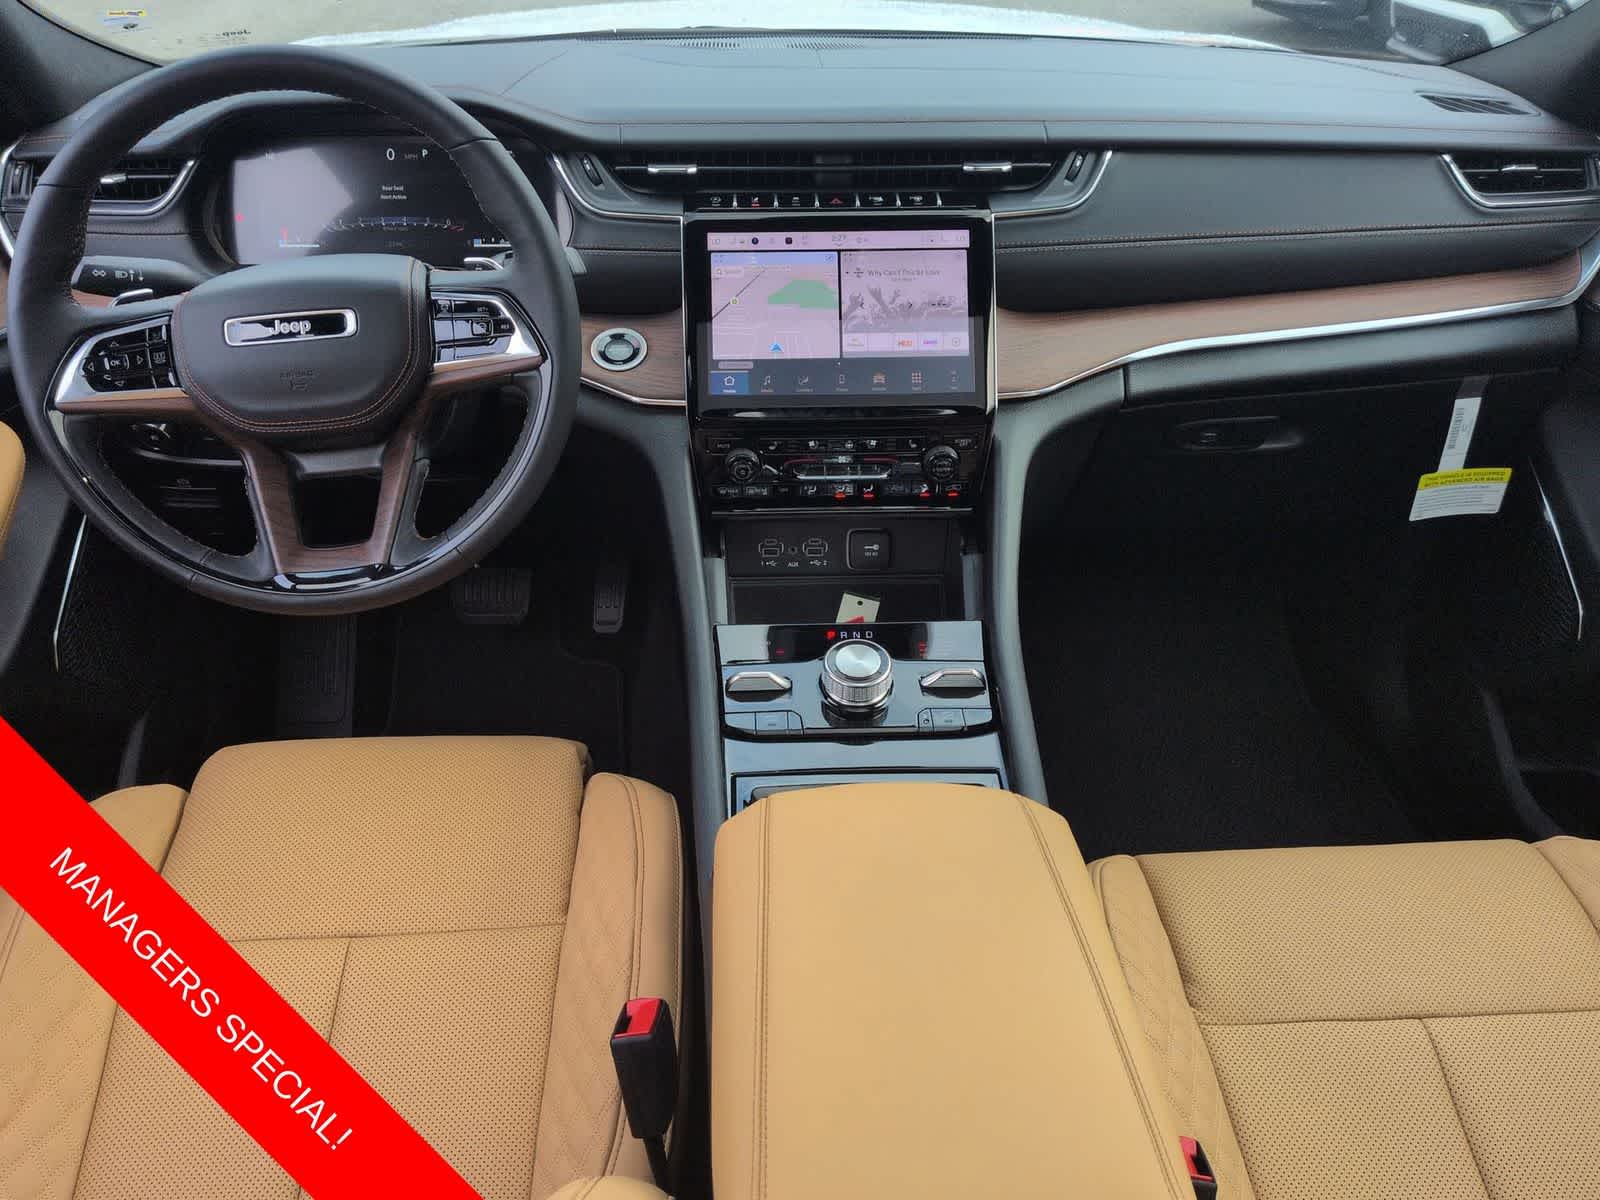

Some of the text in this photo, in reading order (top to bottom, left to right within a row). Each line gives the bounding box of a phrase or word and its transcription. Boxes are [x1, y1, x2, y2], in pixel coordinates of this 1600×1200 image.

[386, 148, 395, 160] 0
[422, 148, 428, 158] P
[271, 319, 312, 335] Jeep
